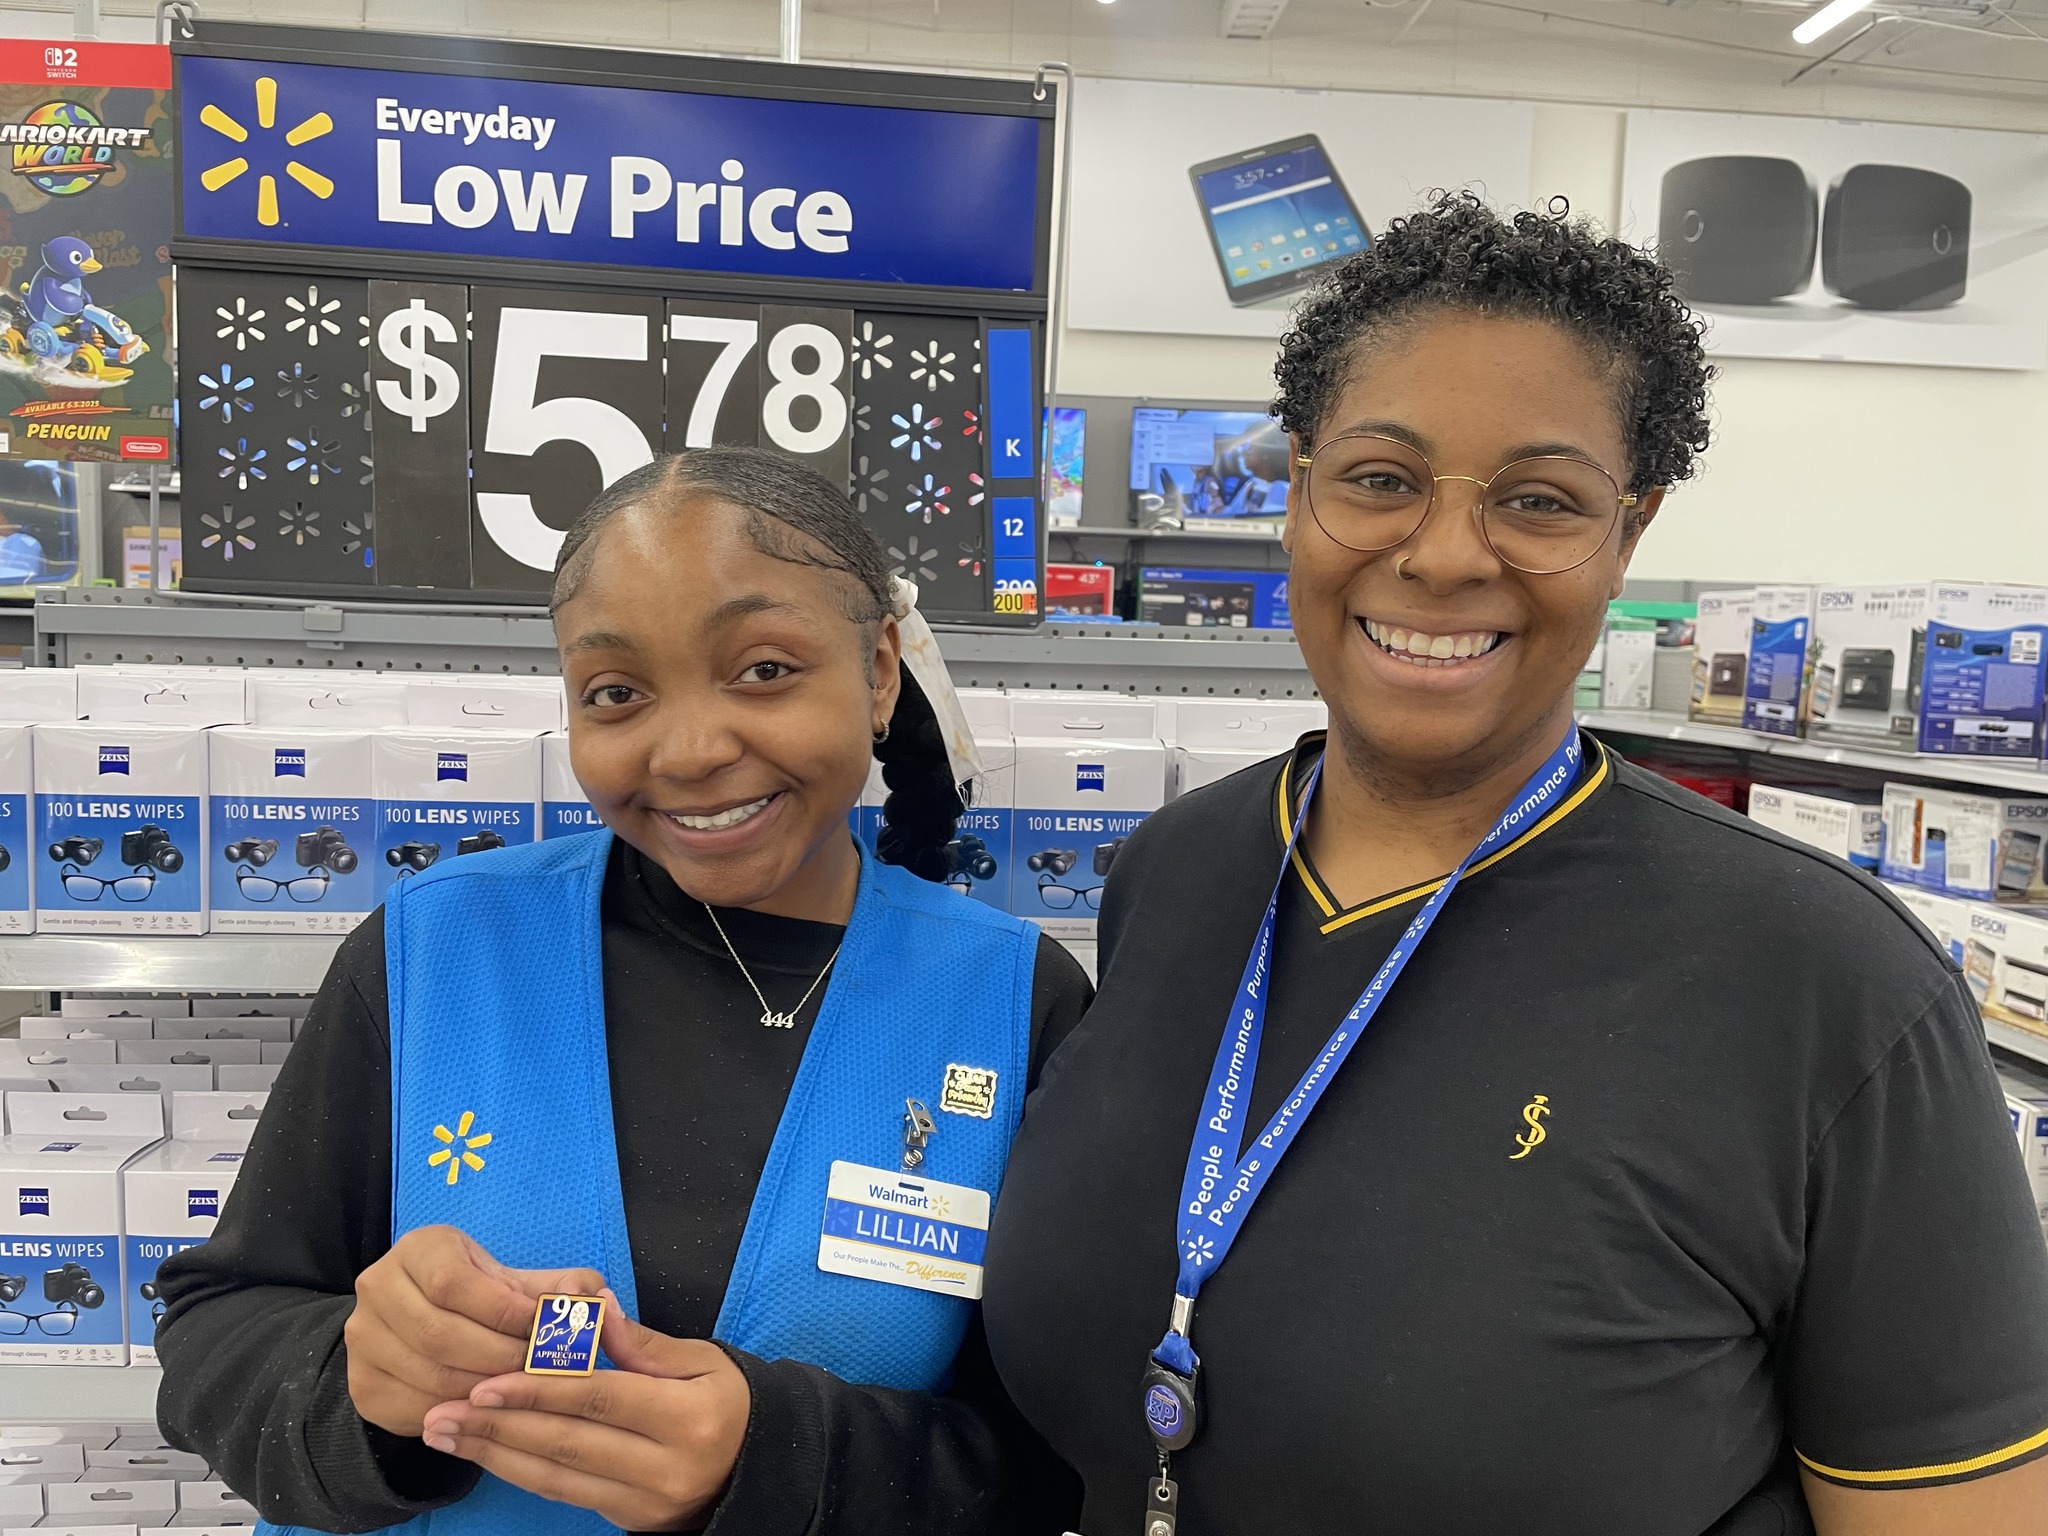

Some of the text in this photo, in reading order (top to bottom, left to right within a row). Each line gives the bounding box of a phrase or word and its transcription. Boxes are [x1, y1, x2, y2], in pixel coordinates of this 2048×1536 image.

[376, 97, 556, 151] Everyday
[14, 144, 112, 167] WORLD
[376, 138, 854, 254] Low Price
[24, 400, 100, 414] AVAILABLE 6.5.2025
[26, 423, 111, 441] PENGUIN
[1005, 438, 1022, 457] K
[1002, 518, 1025, 536] 12
[994, 593, 1023, 611] 200
[99, 753, 129, 762] ZEISS
[275, 756, 305, 764] ZEISS
[438, 760, 467, 768] ZEISS
[1077, 771, 1104, 779] ZEISS
[47, 802, 185, 819] 100 LENS WIPES
[223, 804, 360, 821] 100 LENS WIPES
[385, 808, 520, 825] 100 LENS WIPES
[557, 810, 582, 824] 100
[1027, 816, 1143, 832] 100 LENS WIPE
[73, 919, 97, 927] thorough
[99, 919, 122, 927] cleaning
[218, 918, 235, 926] Gentle
[247, 919, 272, 927] thorough
[273, 919, 296, 927] cleaning
[1971, 914, 2007, 934] EPSON
[760, 1010, 795, 1029] 444
[1188, 926, 1270, 1217] People Performance Purpose
[1208, 950, 1403, 1226] People Performance Purpose
[19, 1195, 49, 1204] ZEISS
[188, 1197, 218, 1206] ZEISS
[868, 1184, 929, 1209] Walmart
[855, 1209, 959, 1254] LILLIAN
[0, 1242, 104, 1258] LENS WIPES
[138, 1243, 163, 1259] 100
[833, 1251, 847, 1260] Our
[847, 1254, 869, 1265] People
[870, 1257, 888, 1269] Make
[906, 1260, 968, 1281] Difference
[535, 1350, 588, 1361] APPRECIATE
[556, 1344, 571, 1352] WE
[552, 1358, 570, 1367] YOU
